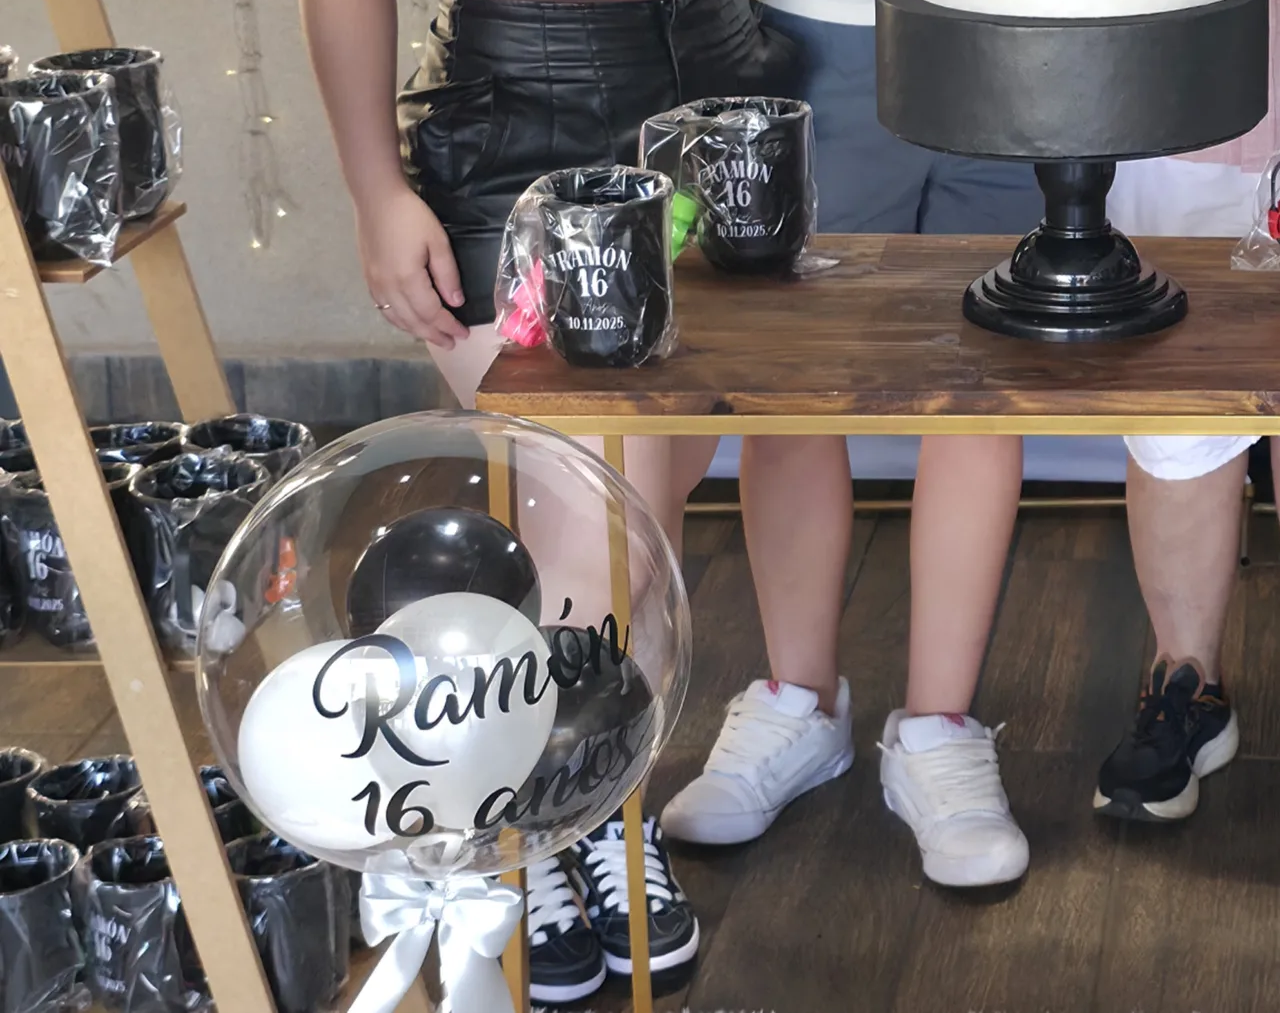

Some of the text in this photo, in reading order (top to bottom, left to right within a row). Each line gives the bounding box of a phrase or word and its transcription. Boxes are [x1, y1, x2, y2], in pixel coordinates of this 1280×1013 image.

[724, 180, 752, 207] 16
[555, 242, 632, 272] RAMÓN
[577, 267, 609, 298] 16
[312, 597, 630, 767] Ramón
[351, 779, 435, 837] 16
